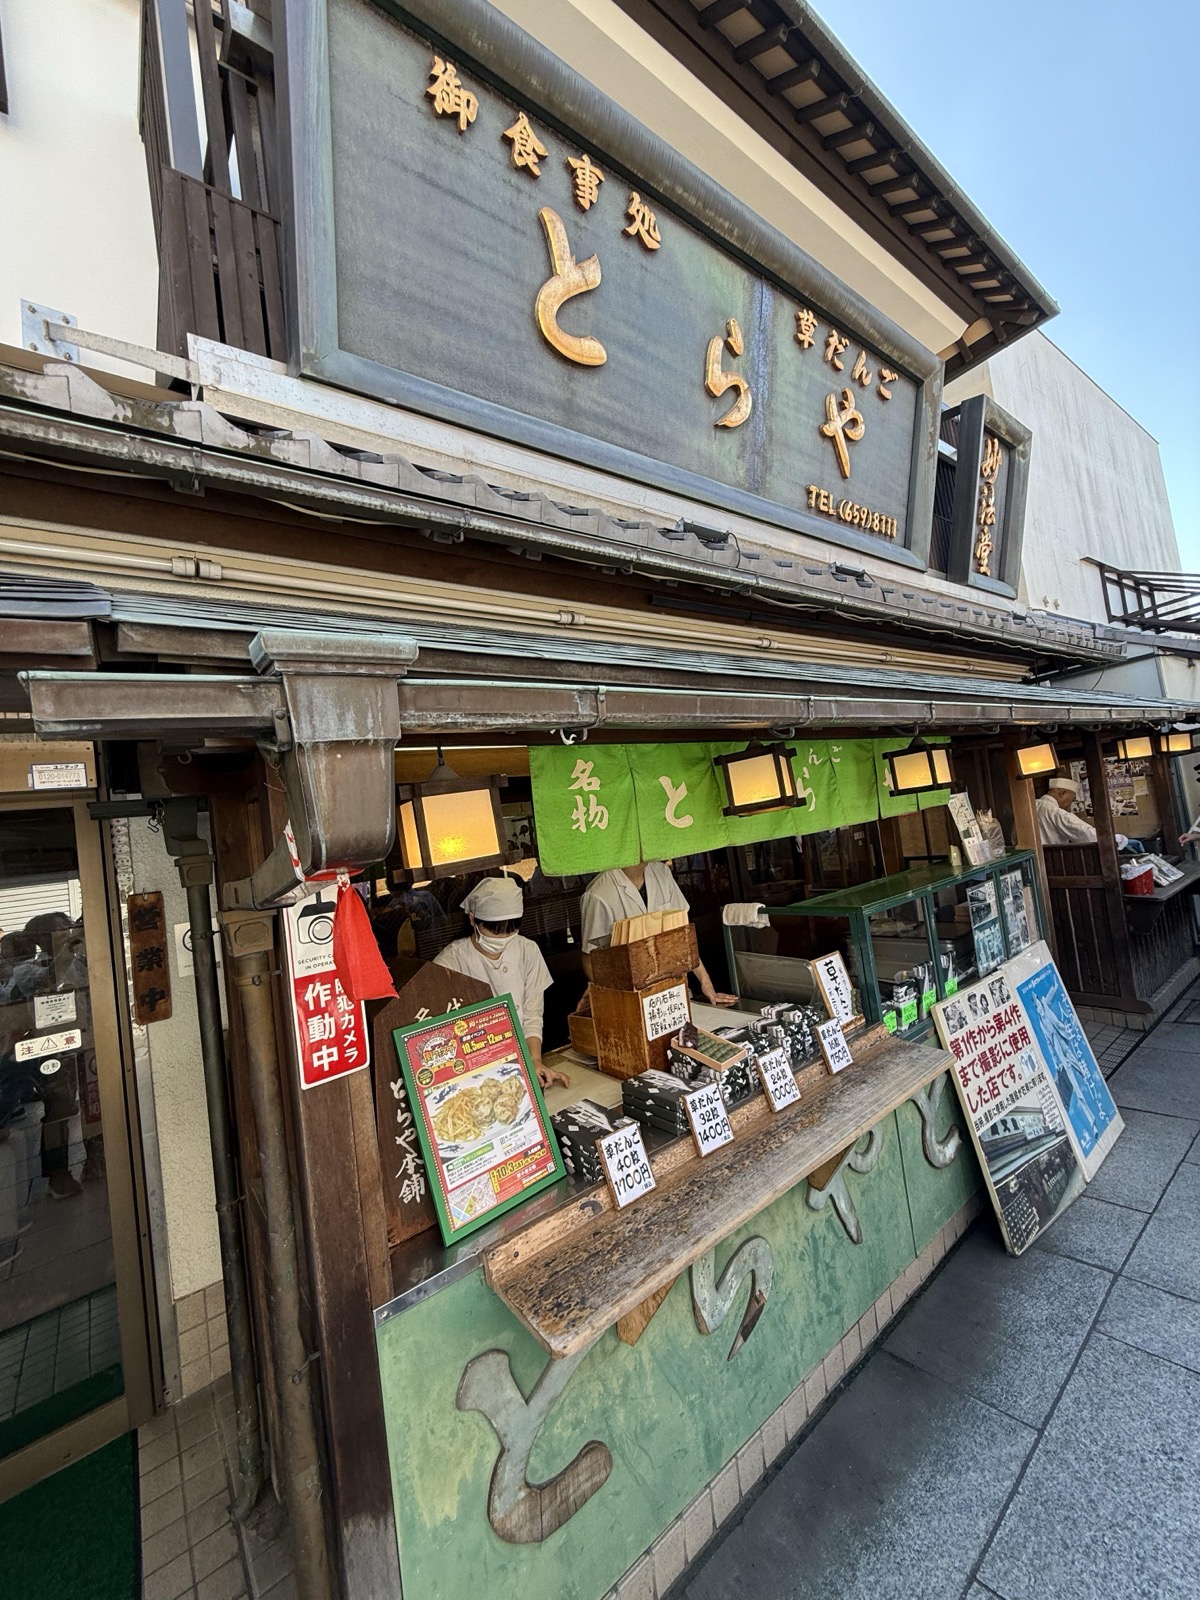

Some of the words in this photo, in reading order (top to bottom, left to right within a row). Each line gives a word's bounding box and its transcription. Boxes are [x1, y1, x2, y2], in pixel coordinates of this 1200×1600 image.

[424, 55, 661, 251] 御食事処
[795, 307, 900, 402] 草だんご
[806, 484, 837, 517] TEL
[568, 758, 609, 833] 名物
[133, 905, 167, 1013] 営業中
[298, 954, 327, 965] SECURITY
[304, 981, 339, 1072] 作動中
[949, 1003, 1022, 1061] 第1作から第4作
[761, 1051, 789, 1075] 草だんご
[958, 1025, 1031, 1089] まで撮影に使用
[688, 1089, 722, 1113] 草だんご
[771, 1079, 799, 1103] 1000円
[966, 1062, 1023, 1114] した店です。
[697, 1120, 731, 1145] 1400円
[699, 1106, 720, 1126] 32粒
[390, 1078, 428, 1204] とらや本舗
[604, 1128, 641, 1160] 草だんご
[615, 1152, 642, 1174] 40粒
[613, 1165, 652, 1196] 1700円
